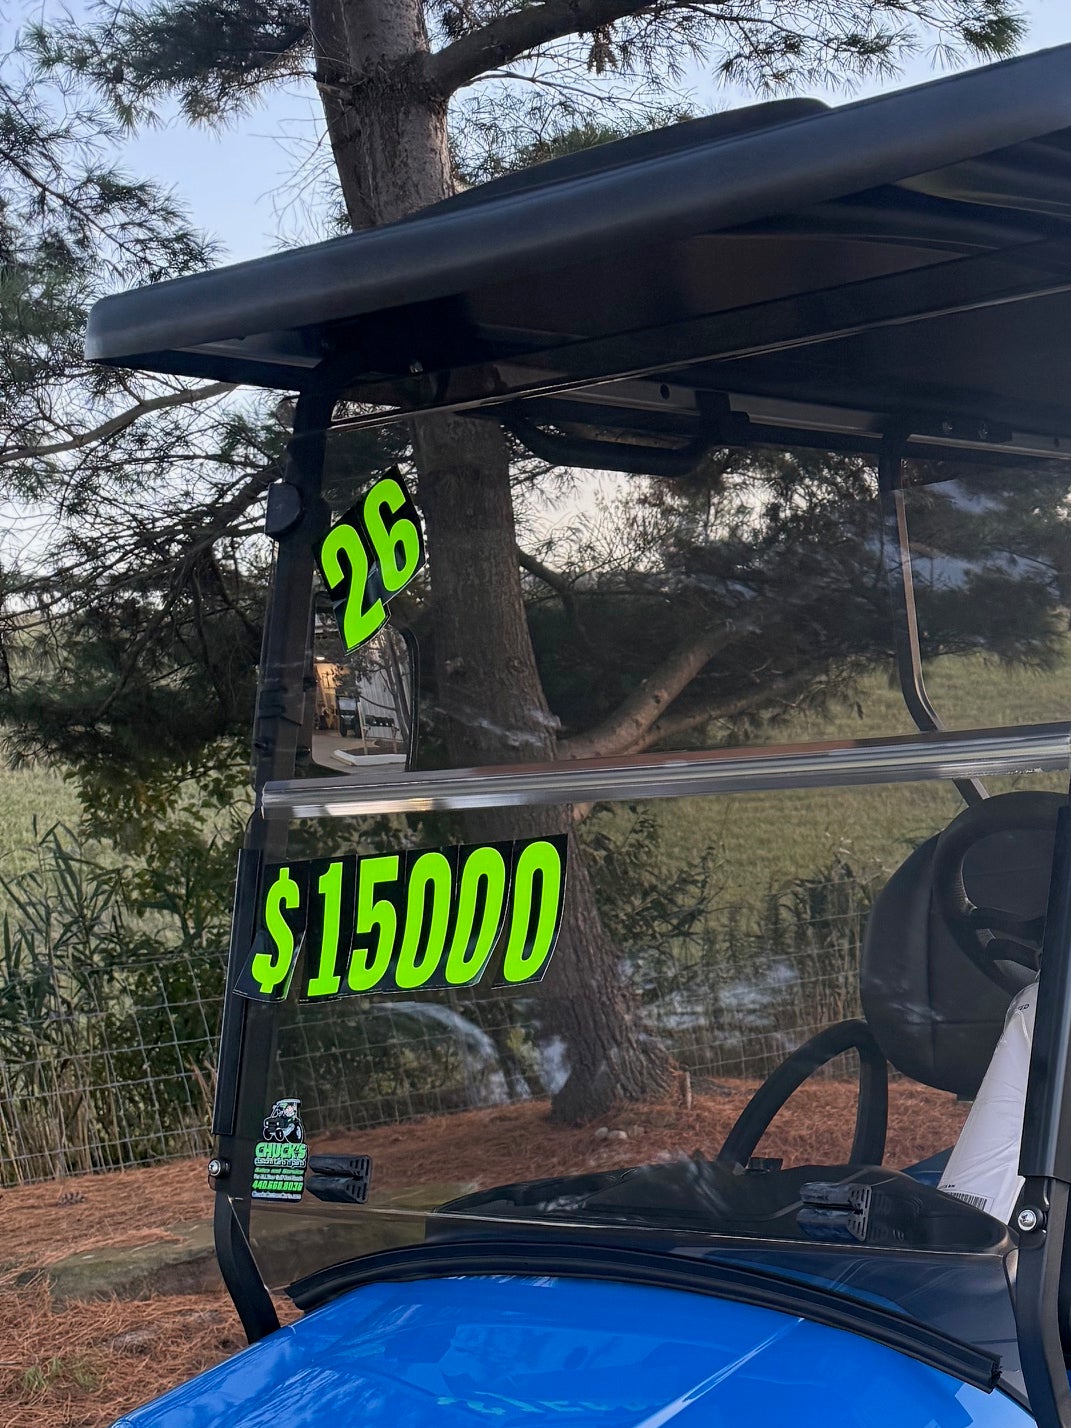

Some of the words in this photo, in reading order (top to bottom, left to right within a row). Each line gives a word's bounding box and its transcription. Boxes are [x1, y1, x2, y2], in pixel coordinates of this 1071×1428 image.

[321, 478, 420, 650] 26
[251, 841, 562, 997] $15000
[255, 1142, 308, 1159] CHUCK'S
